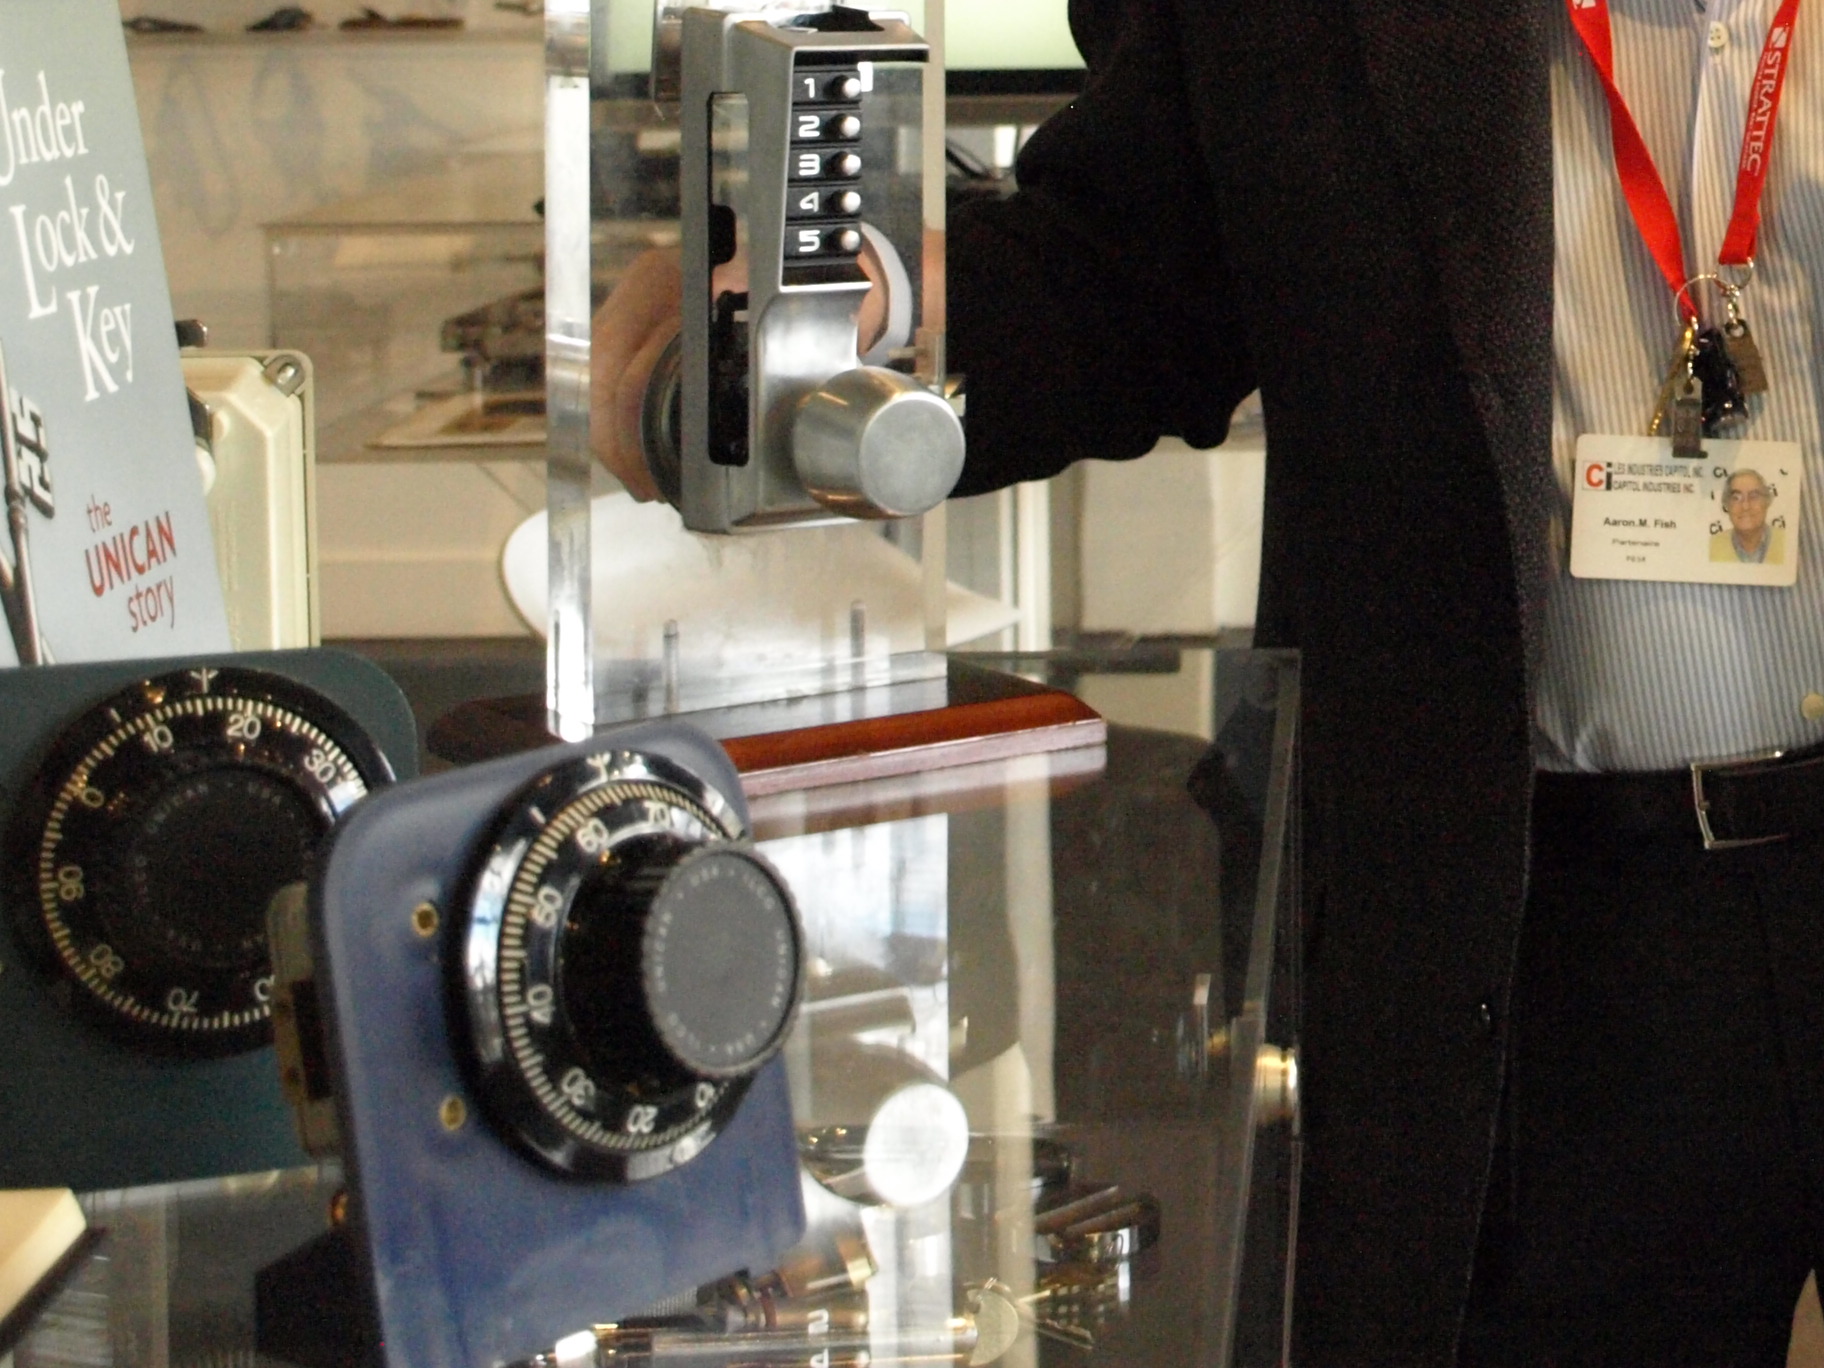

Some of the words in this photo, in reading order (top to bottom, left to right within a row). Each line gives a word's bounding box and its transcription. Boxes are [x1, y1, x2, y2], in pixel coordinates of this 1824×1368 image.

[804, 78, 816, 99] 1
[798, 116, 820, 138] 2
[1742, 49, 1782, 174] STRATTEC
[798, 154, 820, 176] 3
[799, 191, 820, 213] 4
[11, 175, 96, 319] Lock
[95, 172, 135, 258] &
[799, 230, 820, 252] 5
[66, 284, 134, 404] Key
[86, 494, 112, 533] the
[1653, 518, 1677, 529] Fish
[84, 510, 177, 598] UNICAN
[127, 575, 176, 634] story
[143, 724, 174, 753] 10
[226, 713, 262, 740] 20
[304, 748, 337, 783] 30
[80, 786, 105, 809] 0
[644, 802, 672, 829] 70
[577, 817, 609, 854] 60
[57, 865, 85, 902] 90
[532, 886, 564, 930] 50
[88, 942, 126, 978] 80
[167, 988, 200, 1014] 70
[526, 983, 556, 1026] 40
[561, 1066, 596, 1107] 30
[626, 1103, 659, 1135] 20
